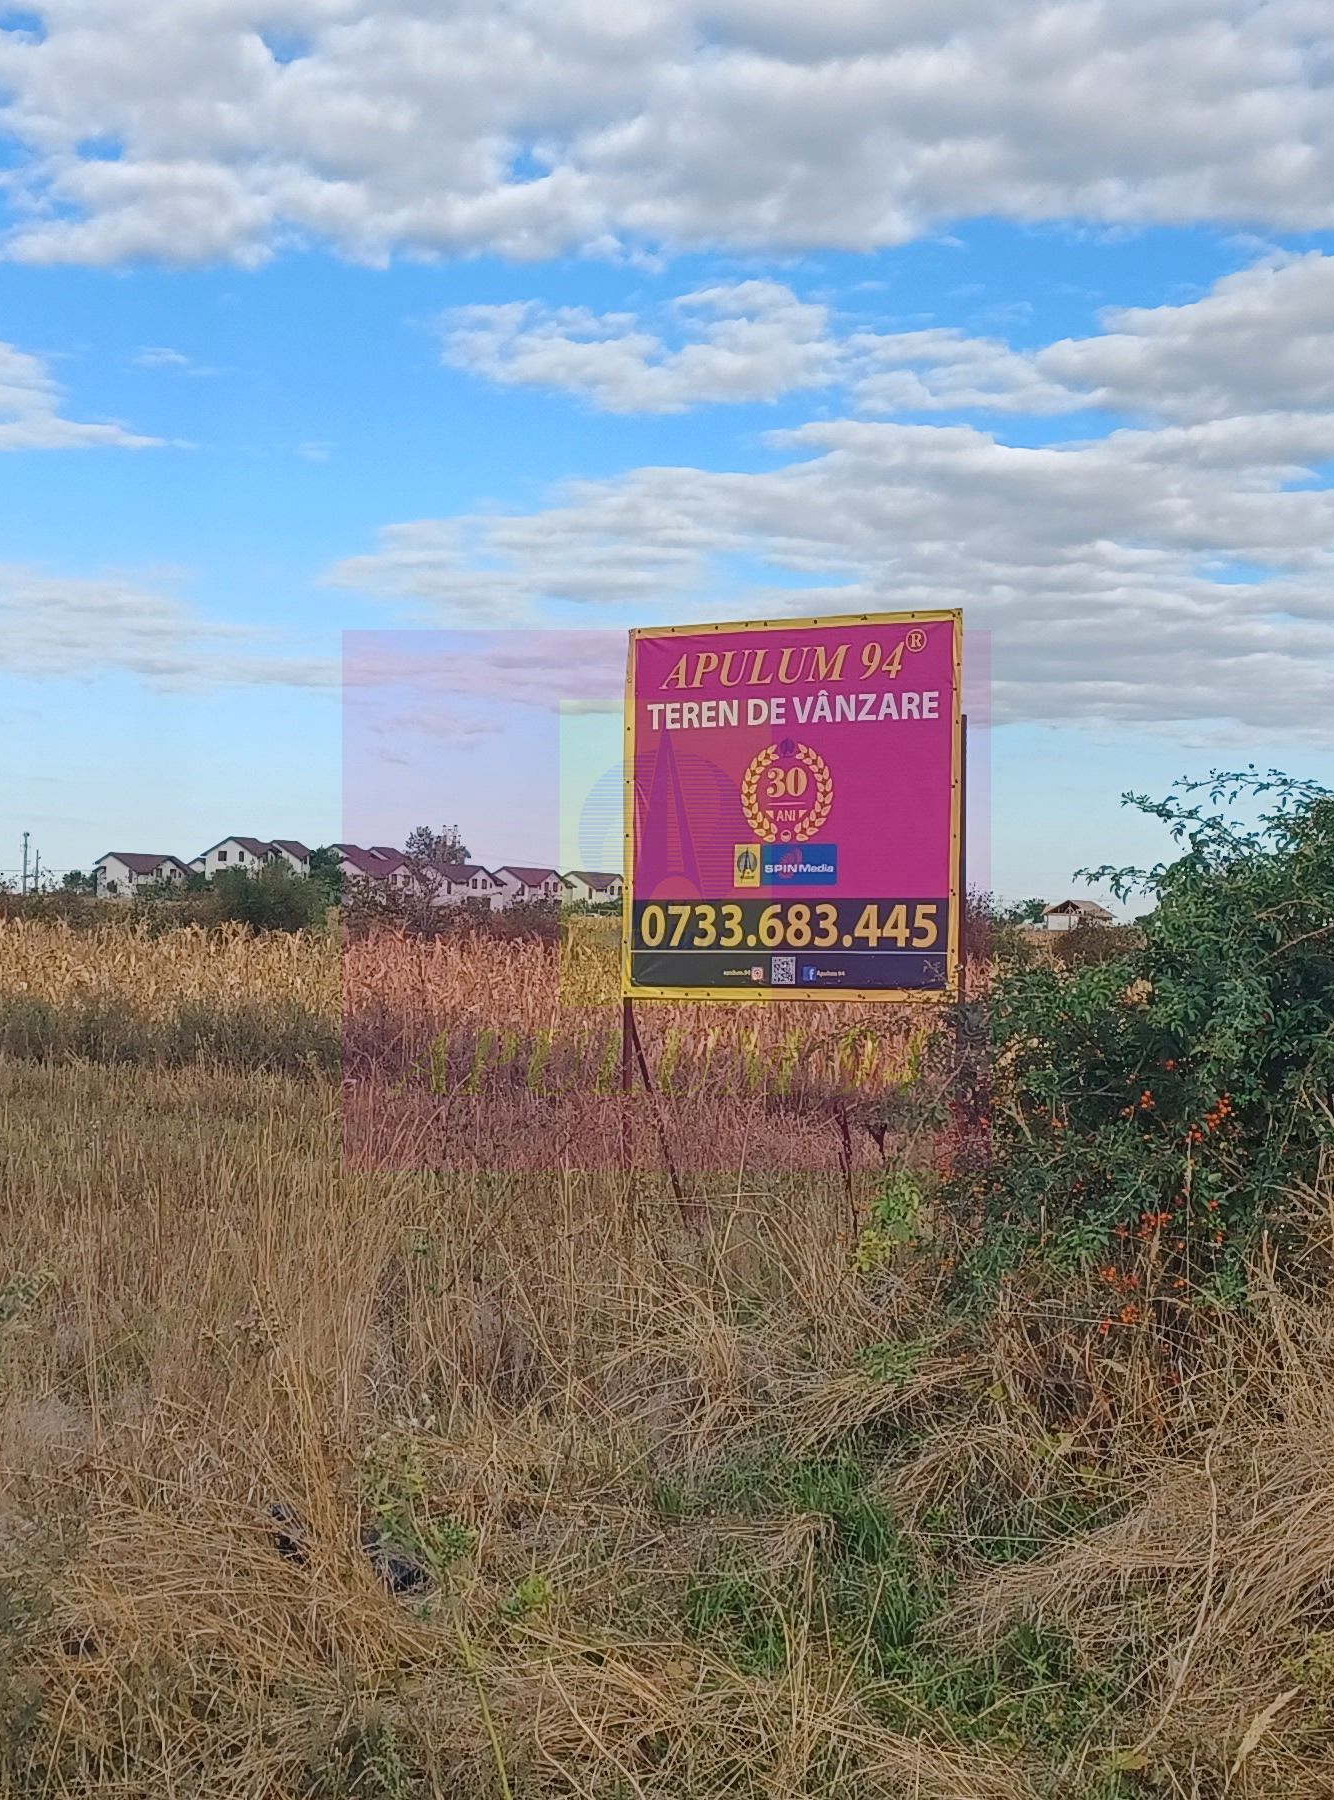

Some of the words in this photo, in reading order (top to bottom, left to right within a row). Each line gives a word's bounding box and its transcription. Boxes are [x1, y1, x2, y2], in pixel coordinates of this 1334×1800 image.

[659, 644, 854, 690] APULUM
[647, 699, 739, 730] TEREN
[747, 697, 787, 726] DE
[793, 690, 940, 724] VÂNZARE
[766, 767, 808, 797] 30
[776, 809, 796, 821] ANI
[641, 904, 939, 948] 0733.683.445
